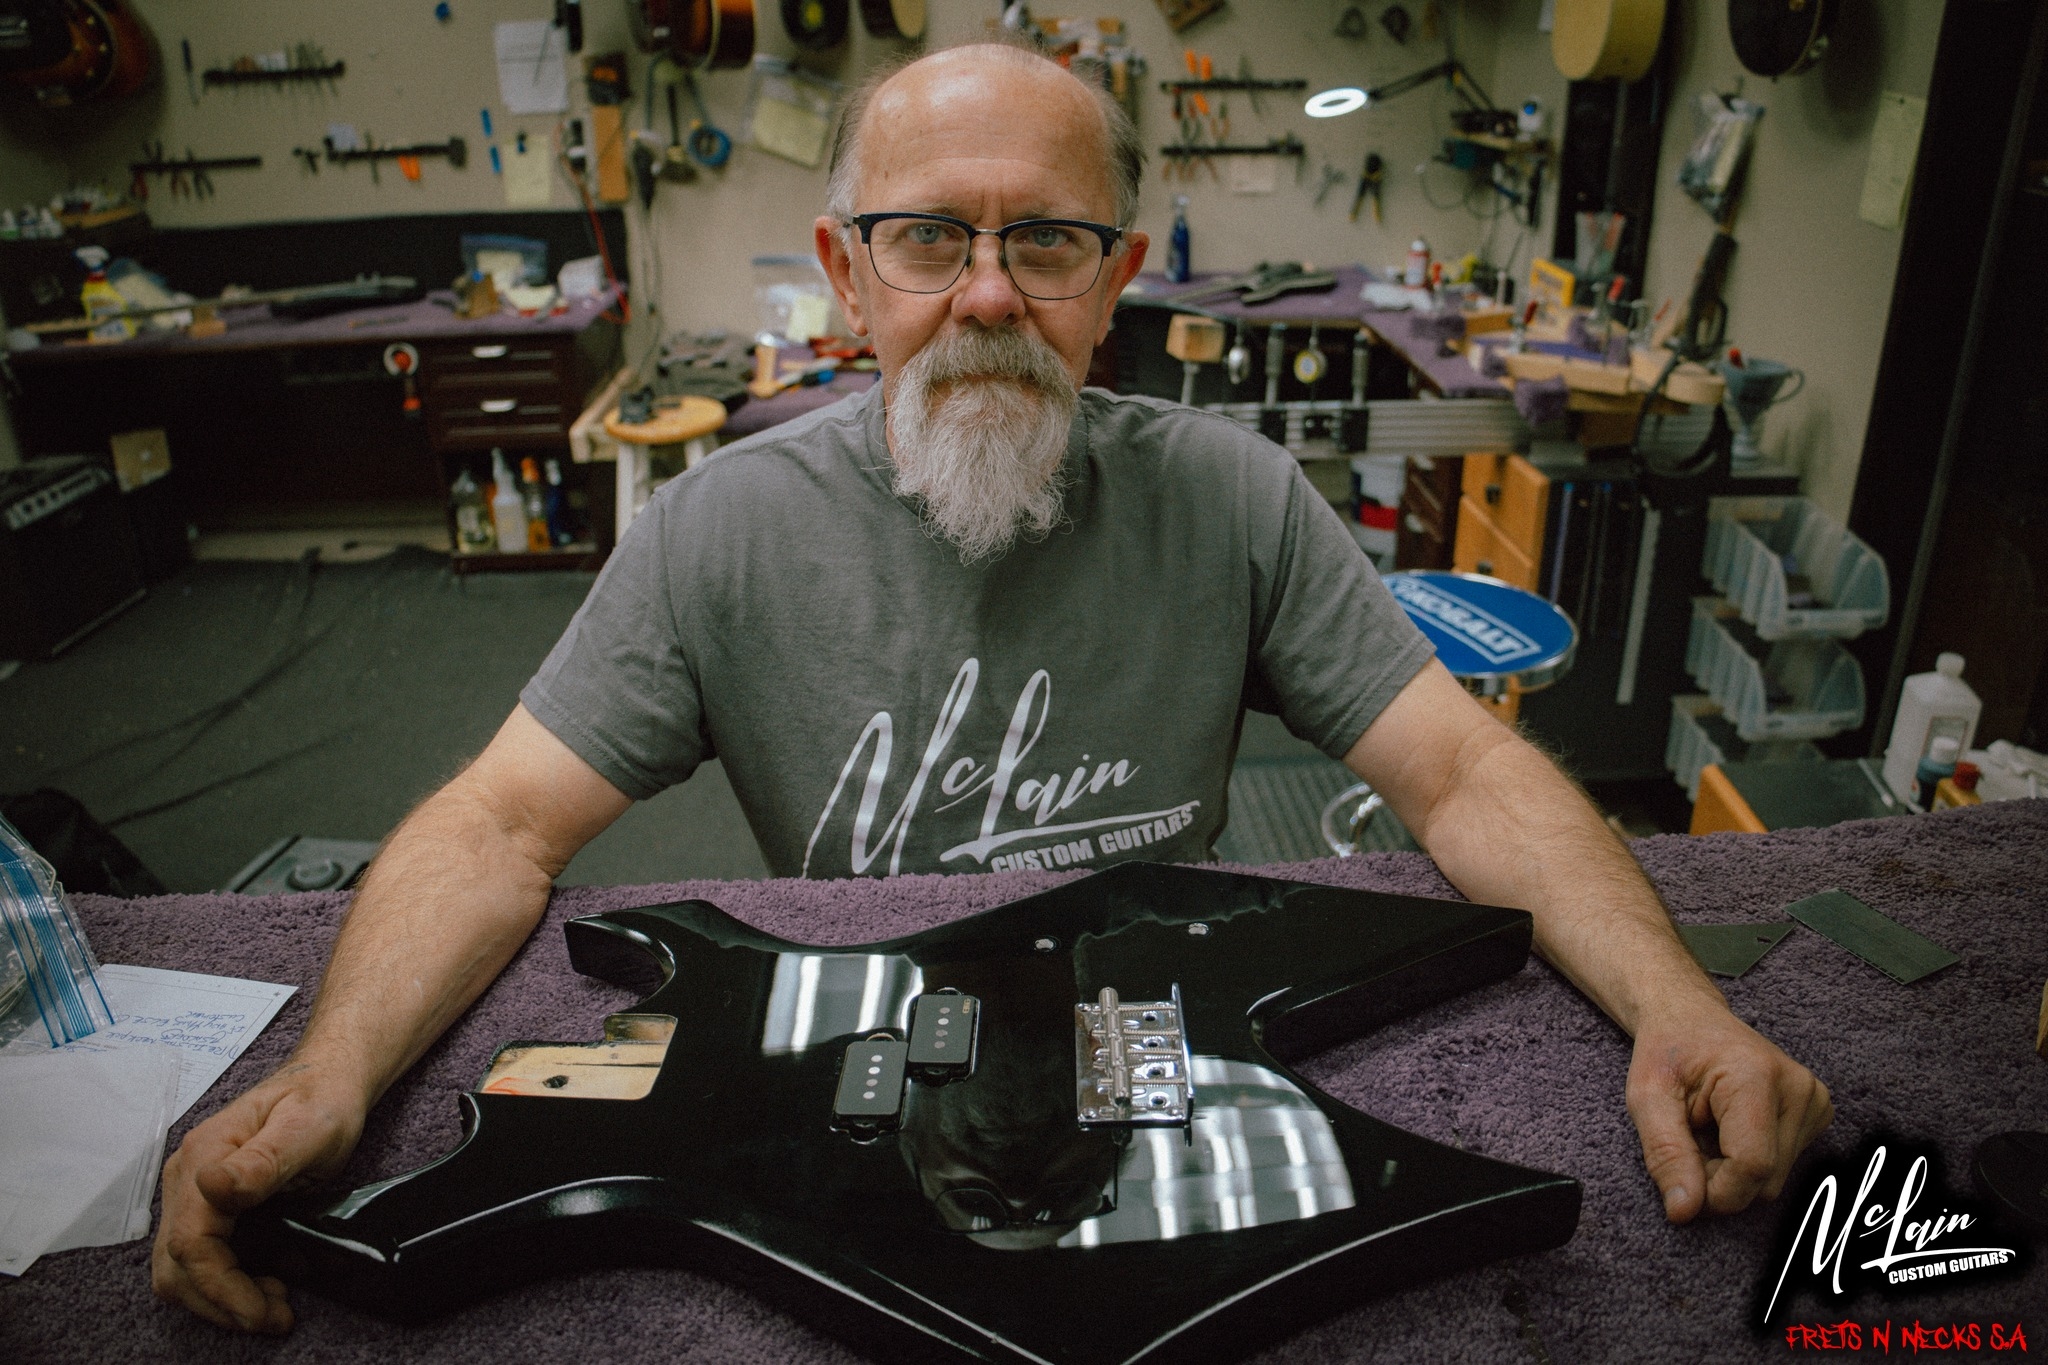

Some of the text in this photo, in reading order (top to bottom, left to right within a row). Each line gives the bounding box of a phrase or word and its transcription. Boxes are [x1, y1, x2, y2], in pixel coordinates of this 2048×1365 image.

[801, 657, 1201, 878] McLain
[990, 806, 1193, 874] CUSTOM GUITARS
